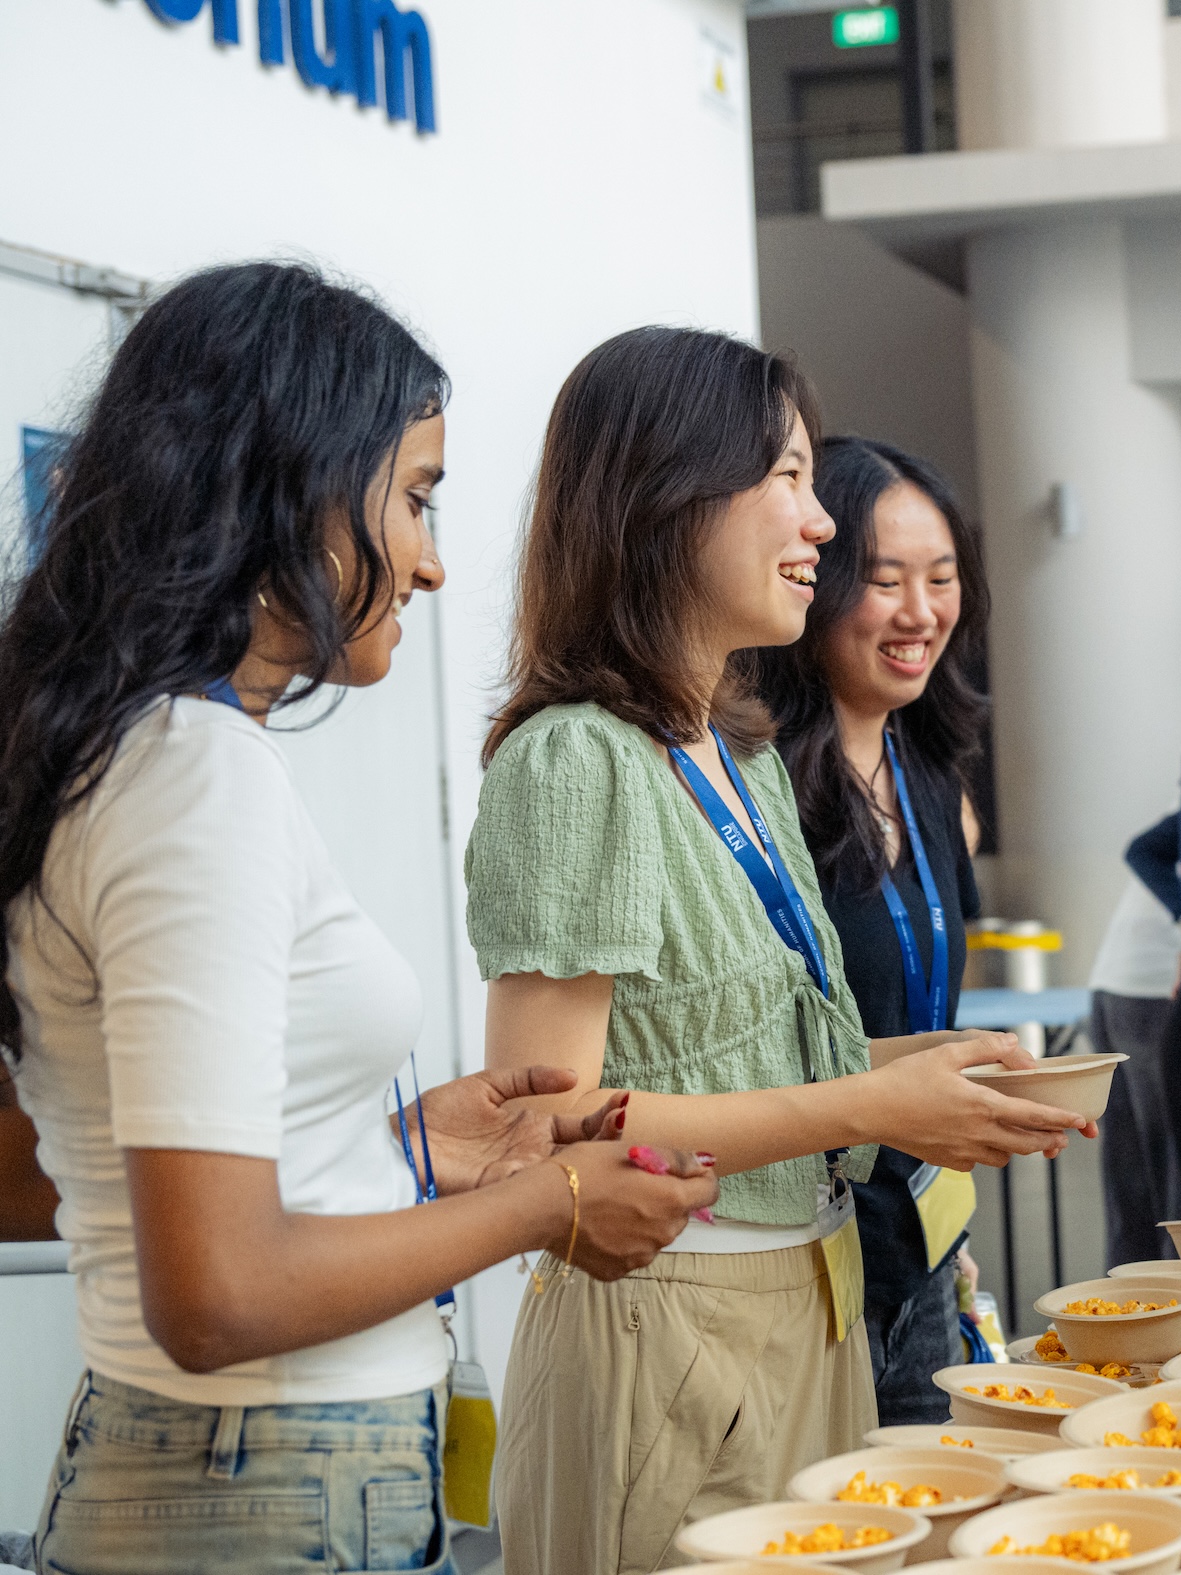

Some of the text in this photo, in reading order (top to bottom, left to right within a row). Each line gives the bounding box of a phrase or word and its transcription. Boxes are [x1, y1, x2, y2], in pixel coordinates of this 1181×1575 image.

[720, 824, 744, 852] NTU
[754, 818, 771, 843] NTU
[776, 908, 800, 944] HUMANITIES
[796, 903, 813, 941] HUMANITIES
[932, 906, 944, 932] NTU
